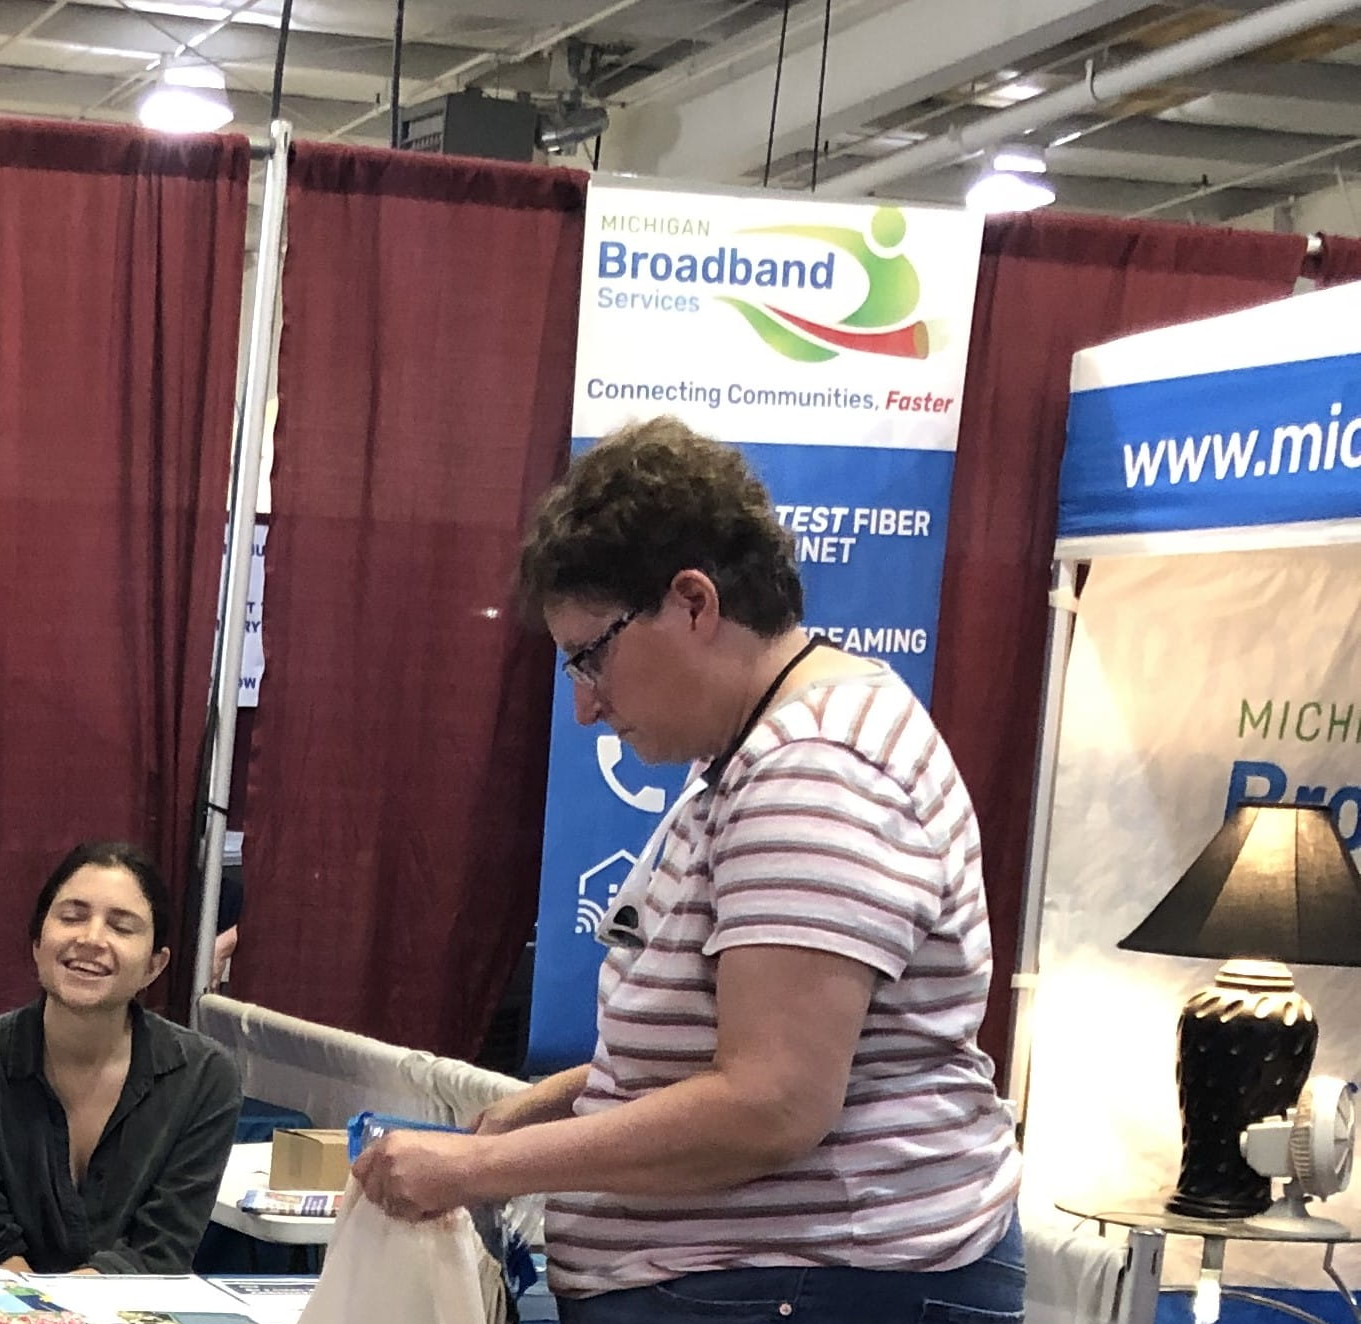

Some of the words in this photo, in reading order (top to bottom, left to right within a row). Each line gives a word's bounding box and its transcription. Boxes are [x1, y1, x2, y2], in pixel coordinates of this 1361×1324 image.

[601, 215, 710, 236] MICHIGAN
[598, 241, 835, 289] Broadband
[597, 286, 700, 312] Services
[587, 378, 721, 409] Connecting
[727, 384, 880, 411] Communities,
[885, 390, 953, 413] Faster
[775, 505, 849, 533] TEST
[853, 508, 931, 537] FIBER
[795, 536, 856, 563] NET
[798, 626, 927, 653] EAMING
